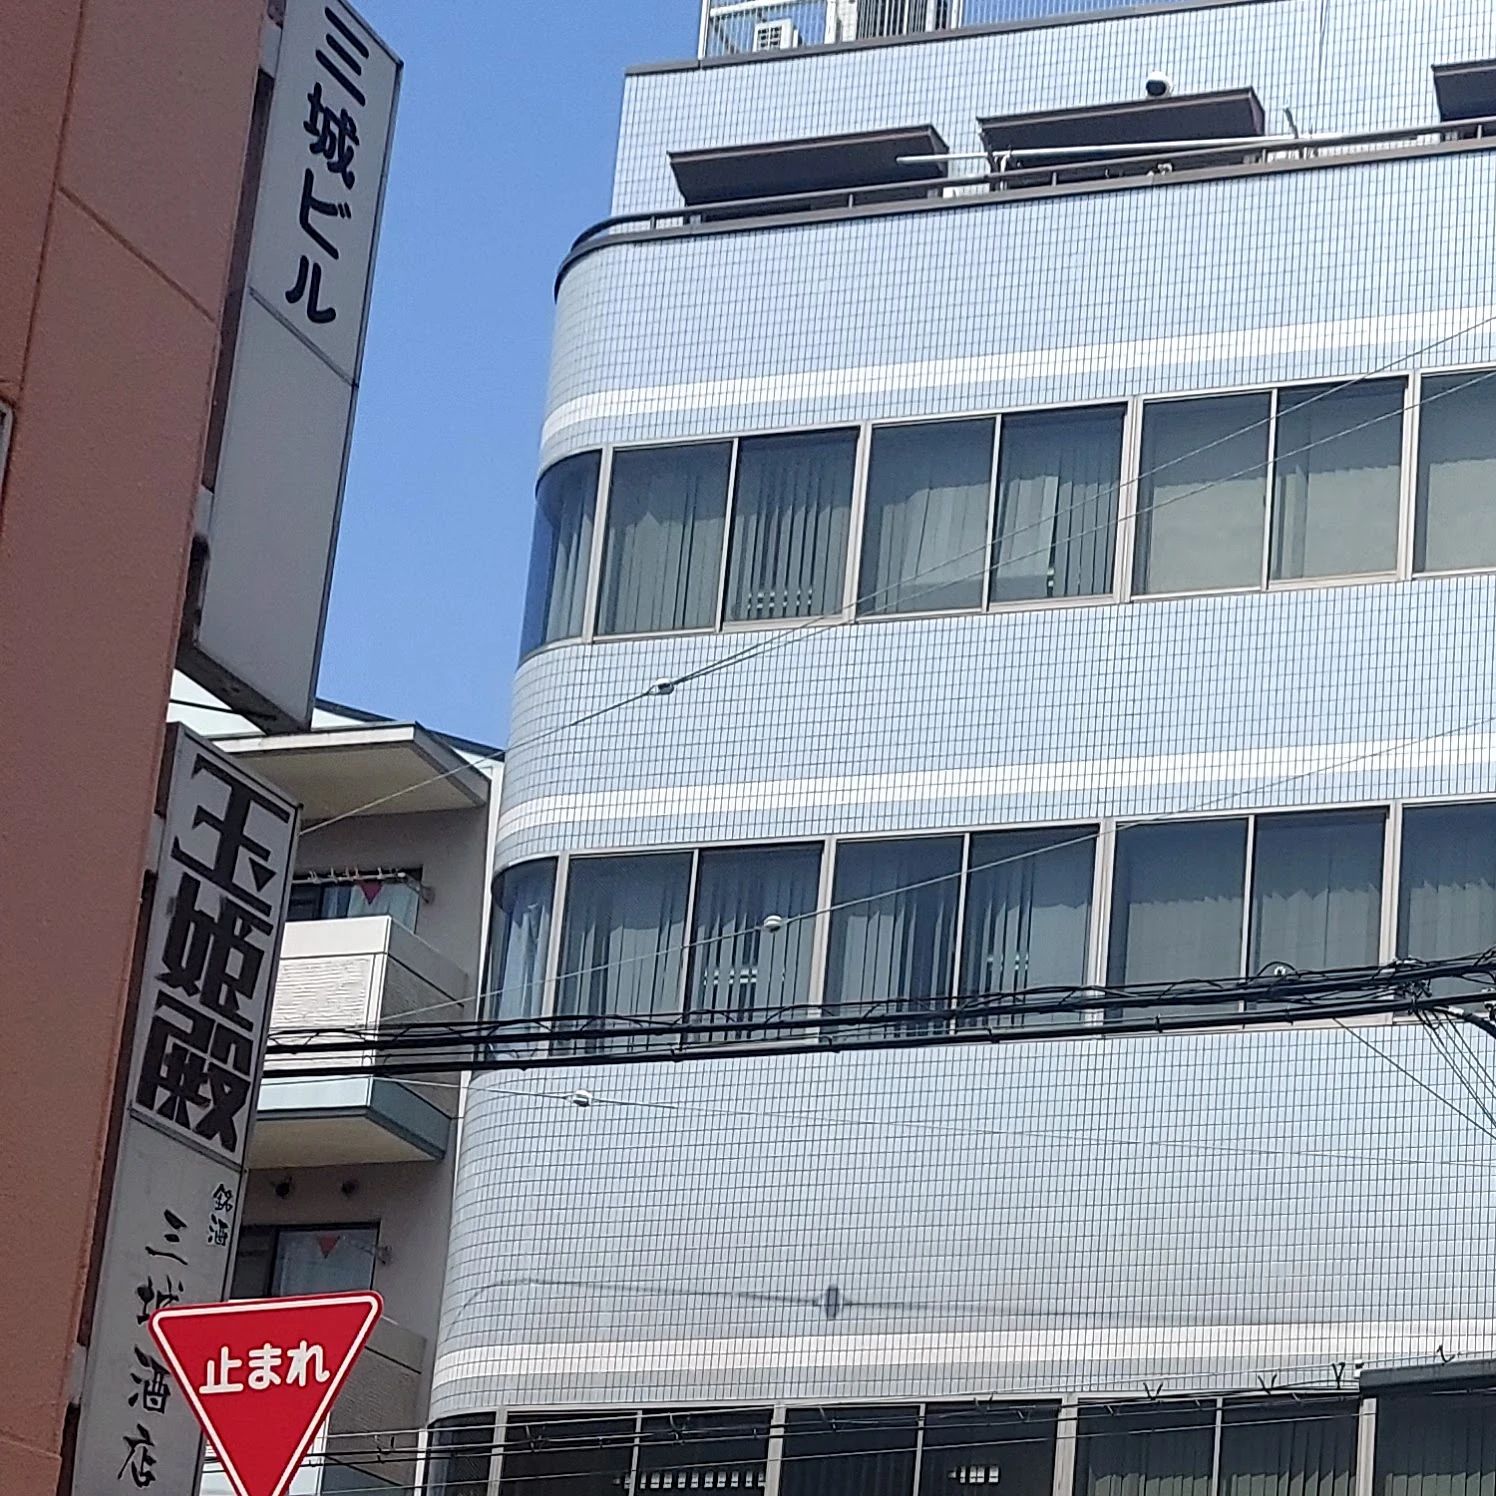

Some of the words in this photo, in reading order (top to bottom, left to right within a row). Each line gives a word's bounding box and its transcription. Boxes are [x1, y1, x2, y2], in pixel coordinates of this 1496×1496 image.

[285, 6, 370, 325] 三城ビル
[199, 1340, 331, 1394] 止まれ
